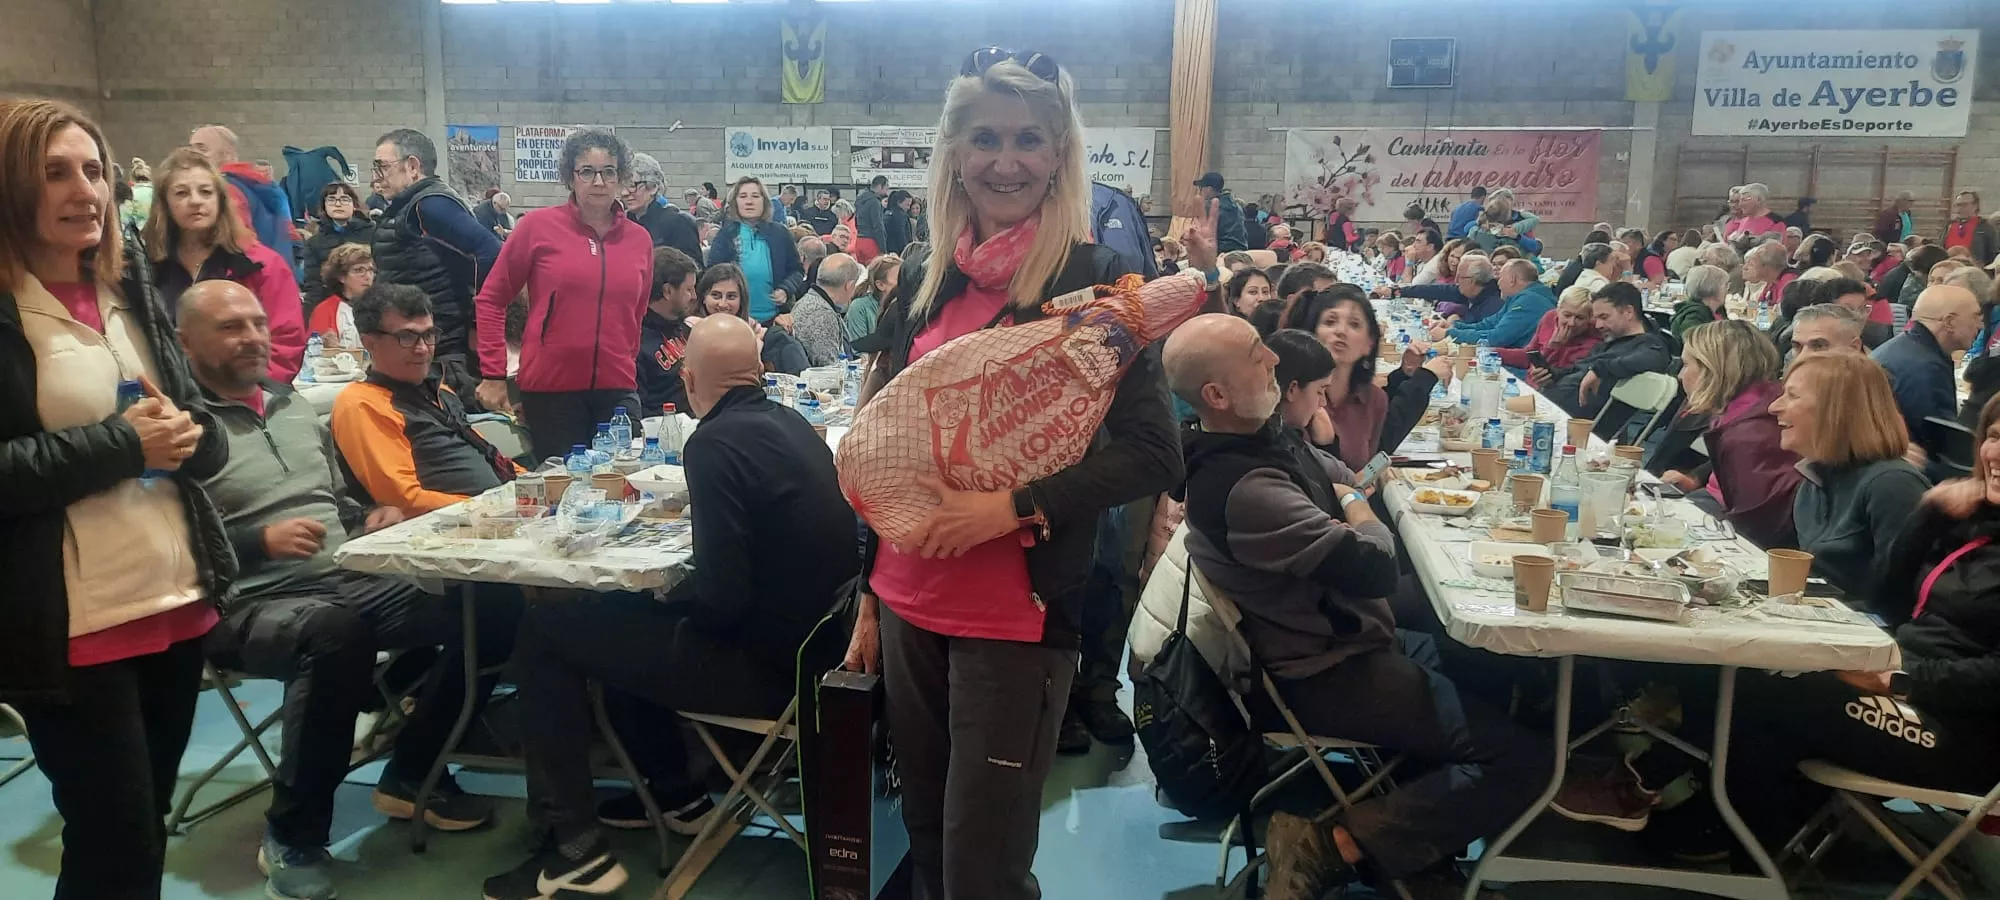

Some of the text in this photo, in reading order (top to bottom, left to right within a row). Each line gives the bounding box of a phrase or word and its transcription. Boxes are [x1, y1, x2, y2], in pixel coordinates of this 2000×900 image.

[1742, 50, 1919, 74] Ayuntamiento
[1704, 79, 1958, 114] Villa de Ayerbe
[1747, 118, 1913, 132] #AyerbeEsDeporte
[516, 127, 566, 138] PLATAFORMA
[450, 143, 497, 152] aventurate
[516, 139, 565, 150] EN DEFENSA
[757, 138, 809, 154] Invayla
[1529, 135, 1593, 165] flor
[530, 149, 553, 159] DE LA
[517, 159, 558, 170] PROPIEDA
[775, 162, 829, 170] APARTAMENTOS
[517, 169, 529, 180] DE
[529, 171, 541, 180] LA
[1090, 171, 1125, 182] sl.com
[1390, 160, 1580, 190] del almendro
[979, 381, 1064, 449] JAMONES
[1019, 396, 1090, 461] CONEJO
[1845, 701, 1936, 749] adidas
[829, 847, 859, 861] edra
